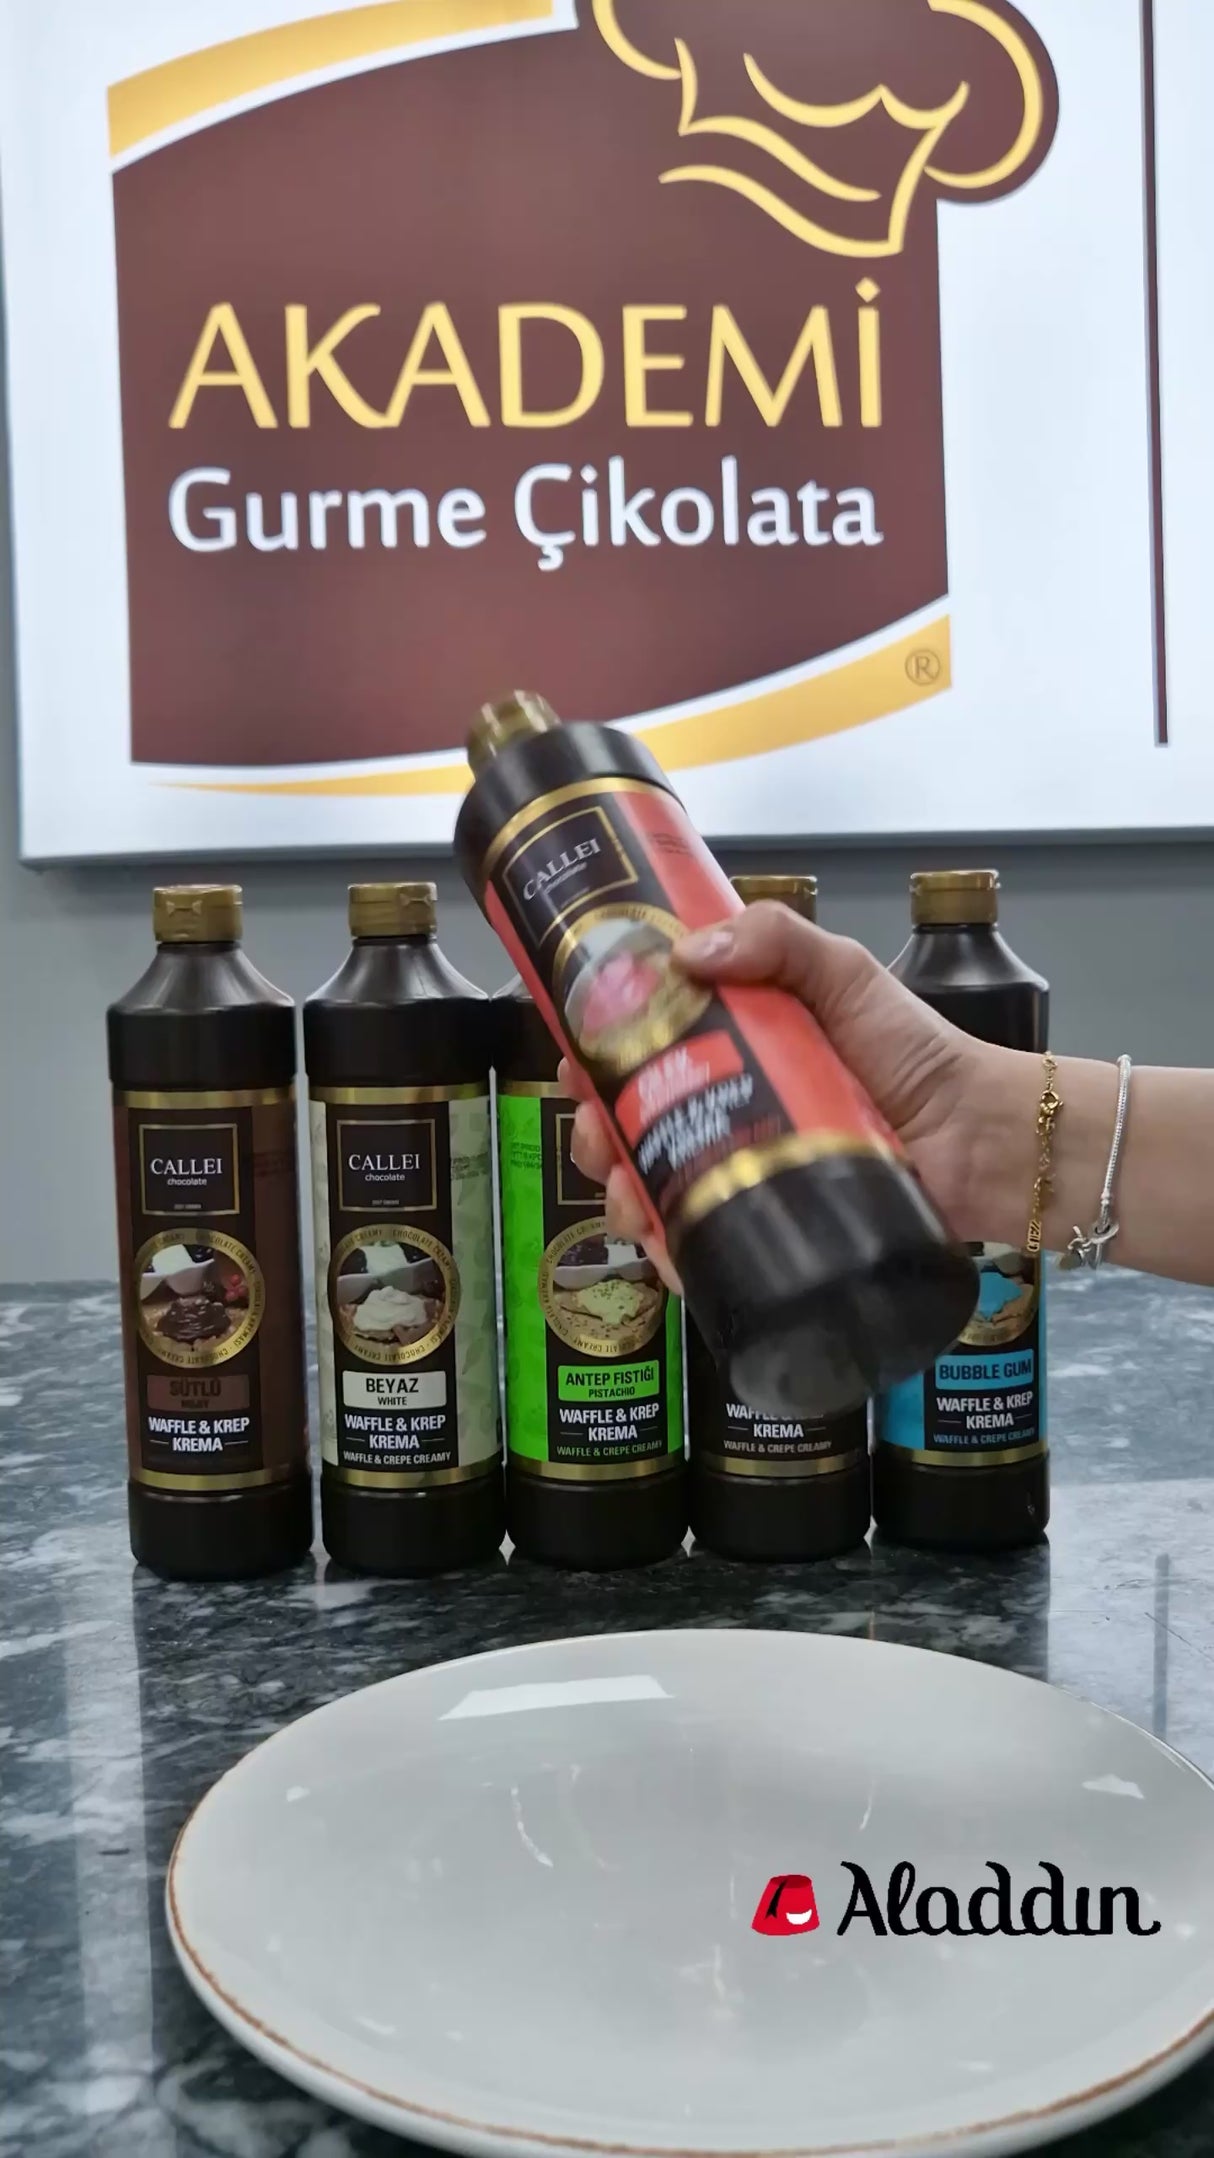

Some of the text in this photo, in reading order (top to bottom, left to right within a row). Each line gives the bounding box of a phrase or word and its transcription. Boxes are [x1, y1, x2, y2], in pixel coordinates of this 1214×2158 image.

[168, 278, 882, 430] AKADEMİ
[168, 456, 884, 571] Gurme Çikolata
[523, 838, 601, 901] CALLEI
[150, 1158, 223, 1175] CALLEI
[349, 1153, 420, 1171] CALLEI
[167, 1178, 207, 1186] chocolate
[365, 1173, 405, 1182] chocolate
[565, 1365, 654, 1387] ANTEP FISTIĞI
[939, 1358, 1032, 1380] BUBBLE GUM
[169, 1377, 221, 1397] SÜTLÜ
[366, 1378, 419, 1393] BEYAZ
[588, 1386, 635, 1398] PISTACHIO
[377, 1396, 407, 1406] WHITE
[936, 1391, 1033, 1413] WAFFLE & KREP
[559, 1402, 660, 1424] WAFFLE & KREP
[966, 1412, 1014, 1430] KREMA
[148, 1416, 250, 1434] WAFFLE & KREP
[344, 1413, 446, 1432] WAFFLE & KREP
[753, 1423, 804, 1438] KREMA
[369, 1434, 420, 1449] KREMA
[588, 1424, 638, 1442] KREMA
[933, 1433, 969, 1445] WAFFLE
[980, 1433, 1007, 1444] CREPE
[173, 1437, 223, 1452] KREMA
[557, 1446, 591, 1457] WAFFLE
[593, 1447, 600, 1457] &
[603, 1446, 630, 1457] CREPE
[724, 1440, 756, 1452] WAFFLE
[758, 1443, 765, 1453] &
[767, 1443, 794, 1453] CREPE
[343, 1450, 451, 1465] WAFFLE & CREPE CREAMY
